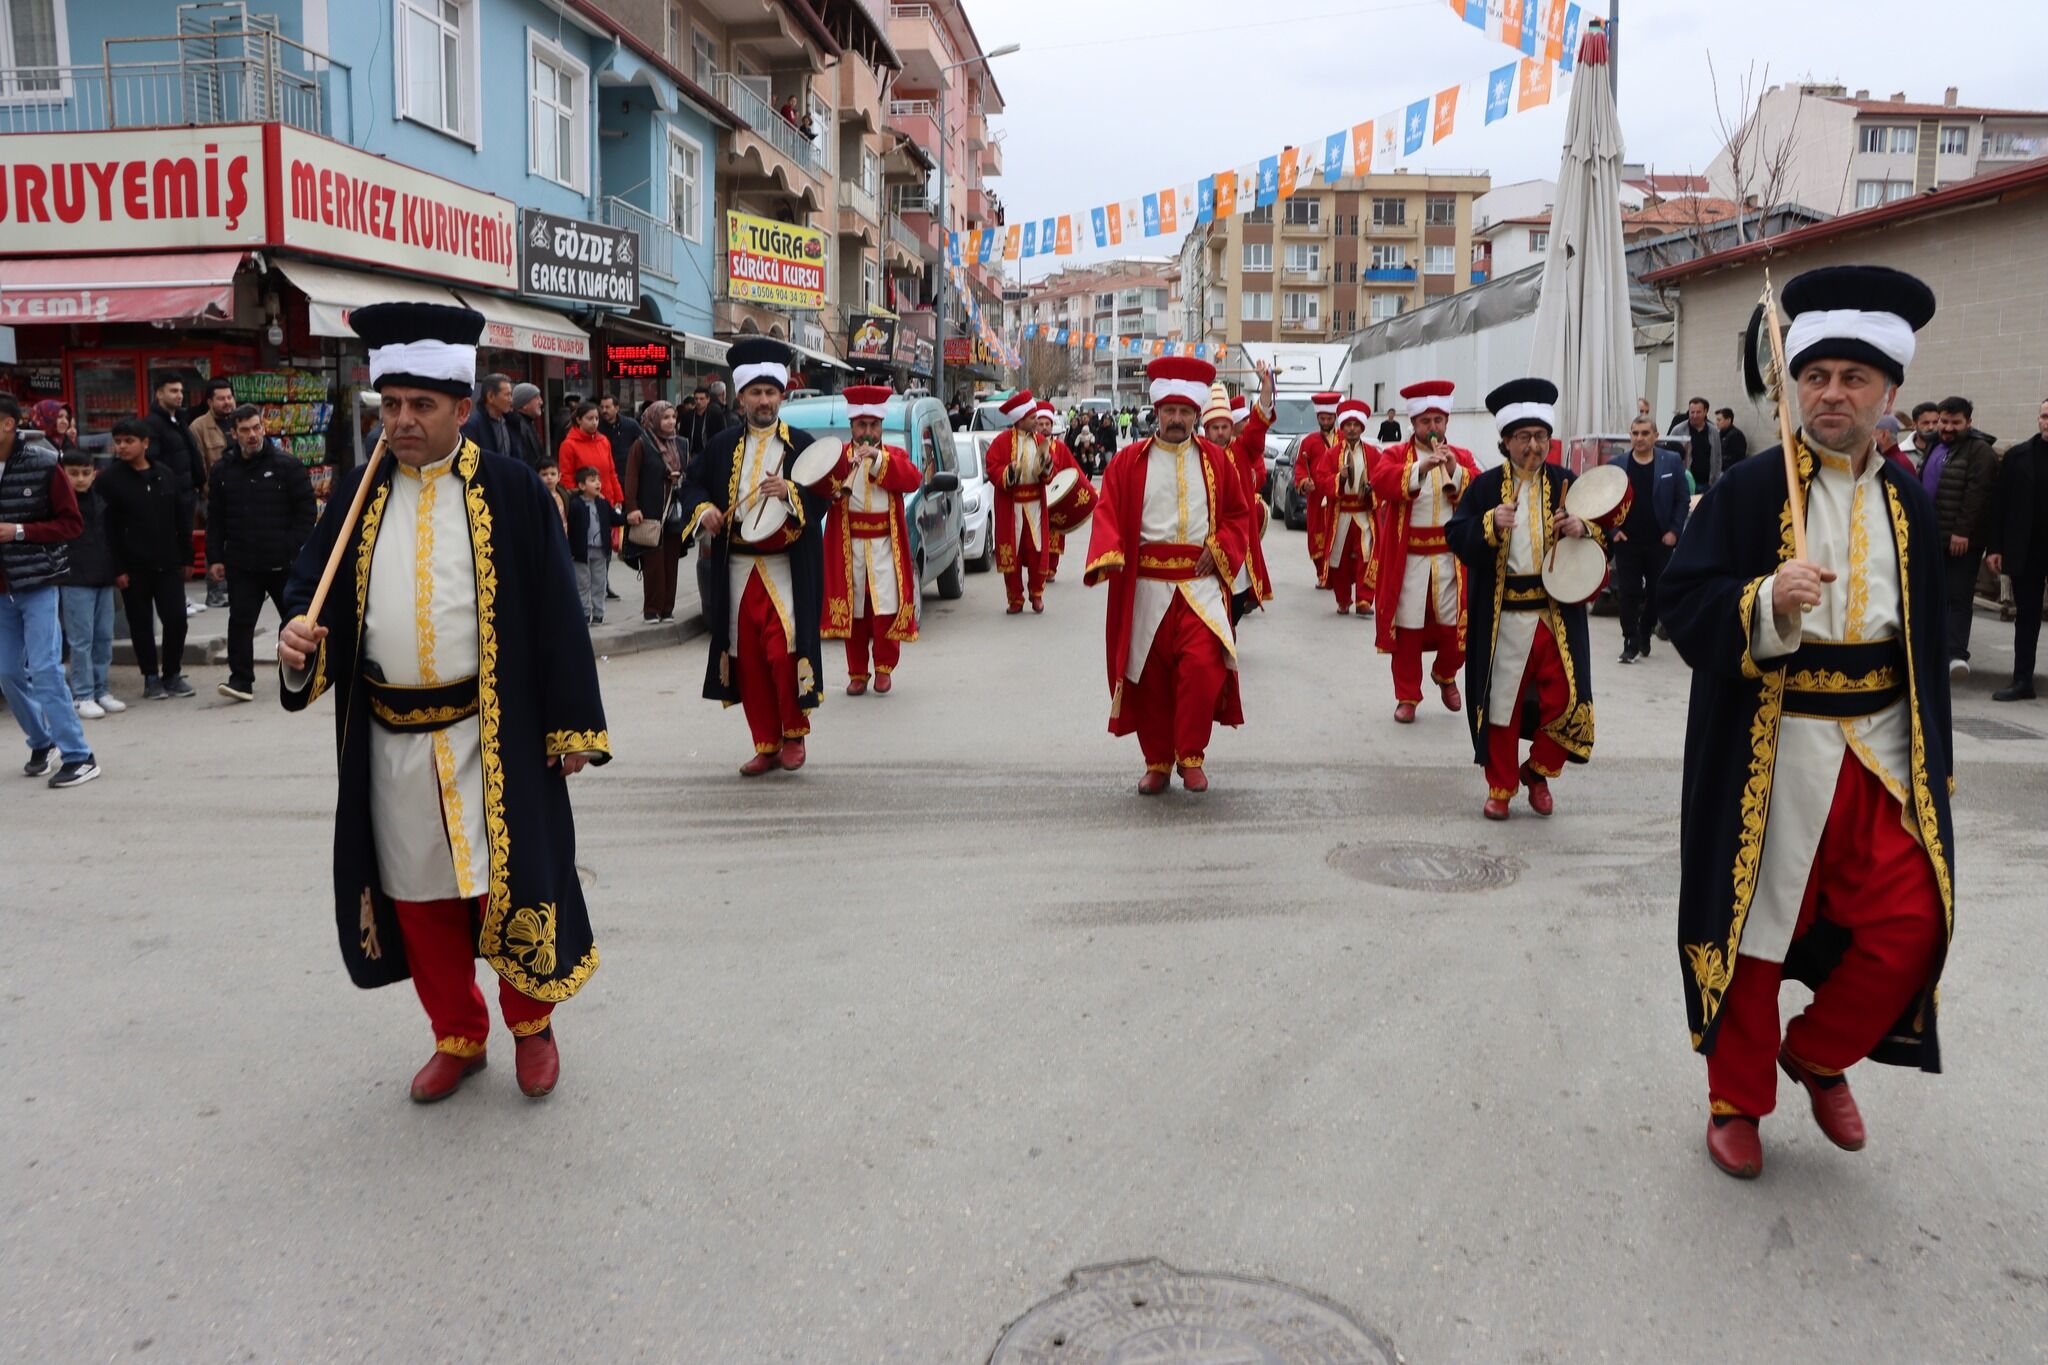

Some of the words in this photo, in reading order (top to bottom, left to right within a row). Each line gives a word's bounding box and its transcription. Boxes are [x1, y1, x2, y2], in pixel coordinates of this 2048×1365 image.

[0, 143, 248, 231] RUYEMİŞ
[291, 159, 396, 242] MERKEZ
[402, 193, 513, 277] KURUYEMİŞ
[554, 222, 614, 266] GÖZDE
[749, 224, 803, 260] TUĞRA
[530, 262, 577, 294] ERKEK
[579, 268, 634, 302] KUAFÖRÜ
[733, 252, 779, 282] SÜRÜCÜ
[782, 264, 819, 289] KURSU
[0, 291, 109, 321] YEMİŞ
[757, 286, 773, 299] 0506
[532, 332, 556, 351] GÖZDE
